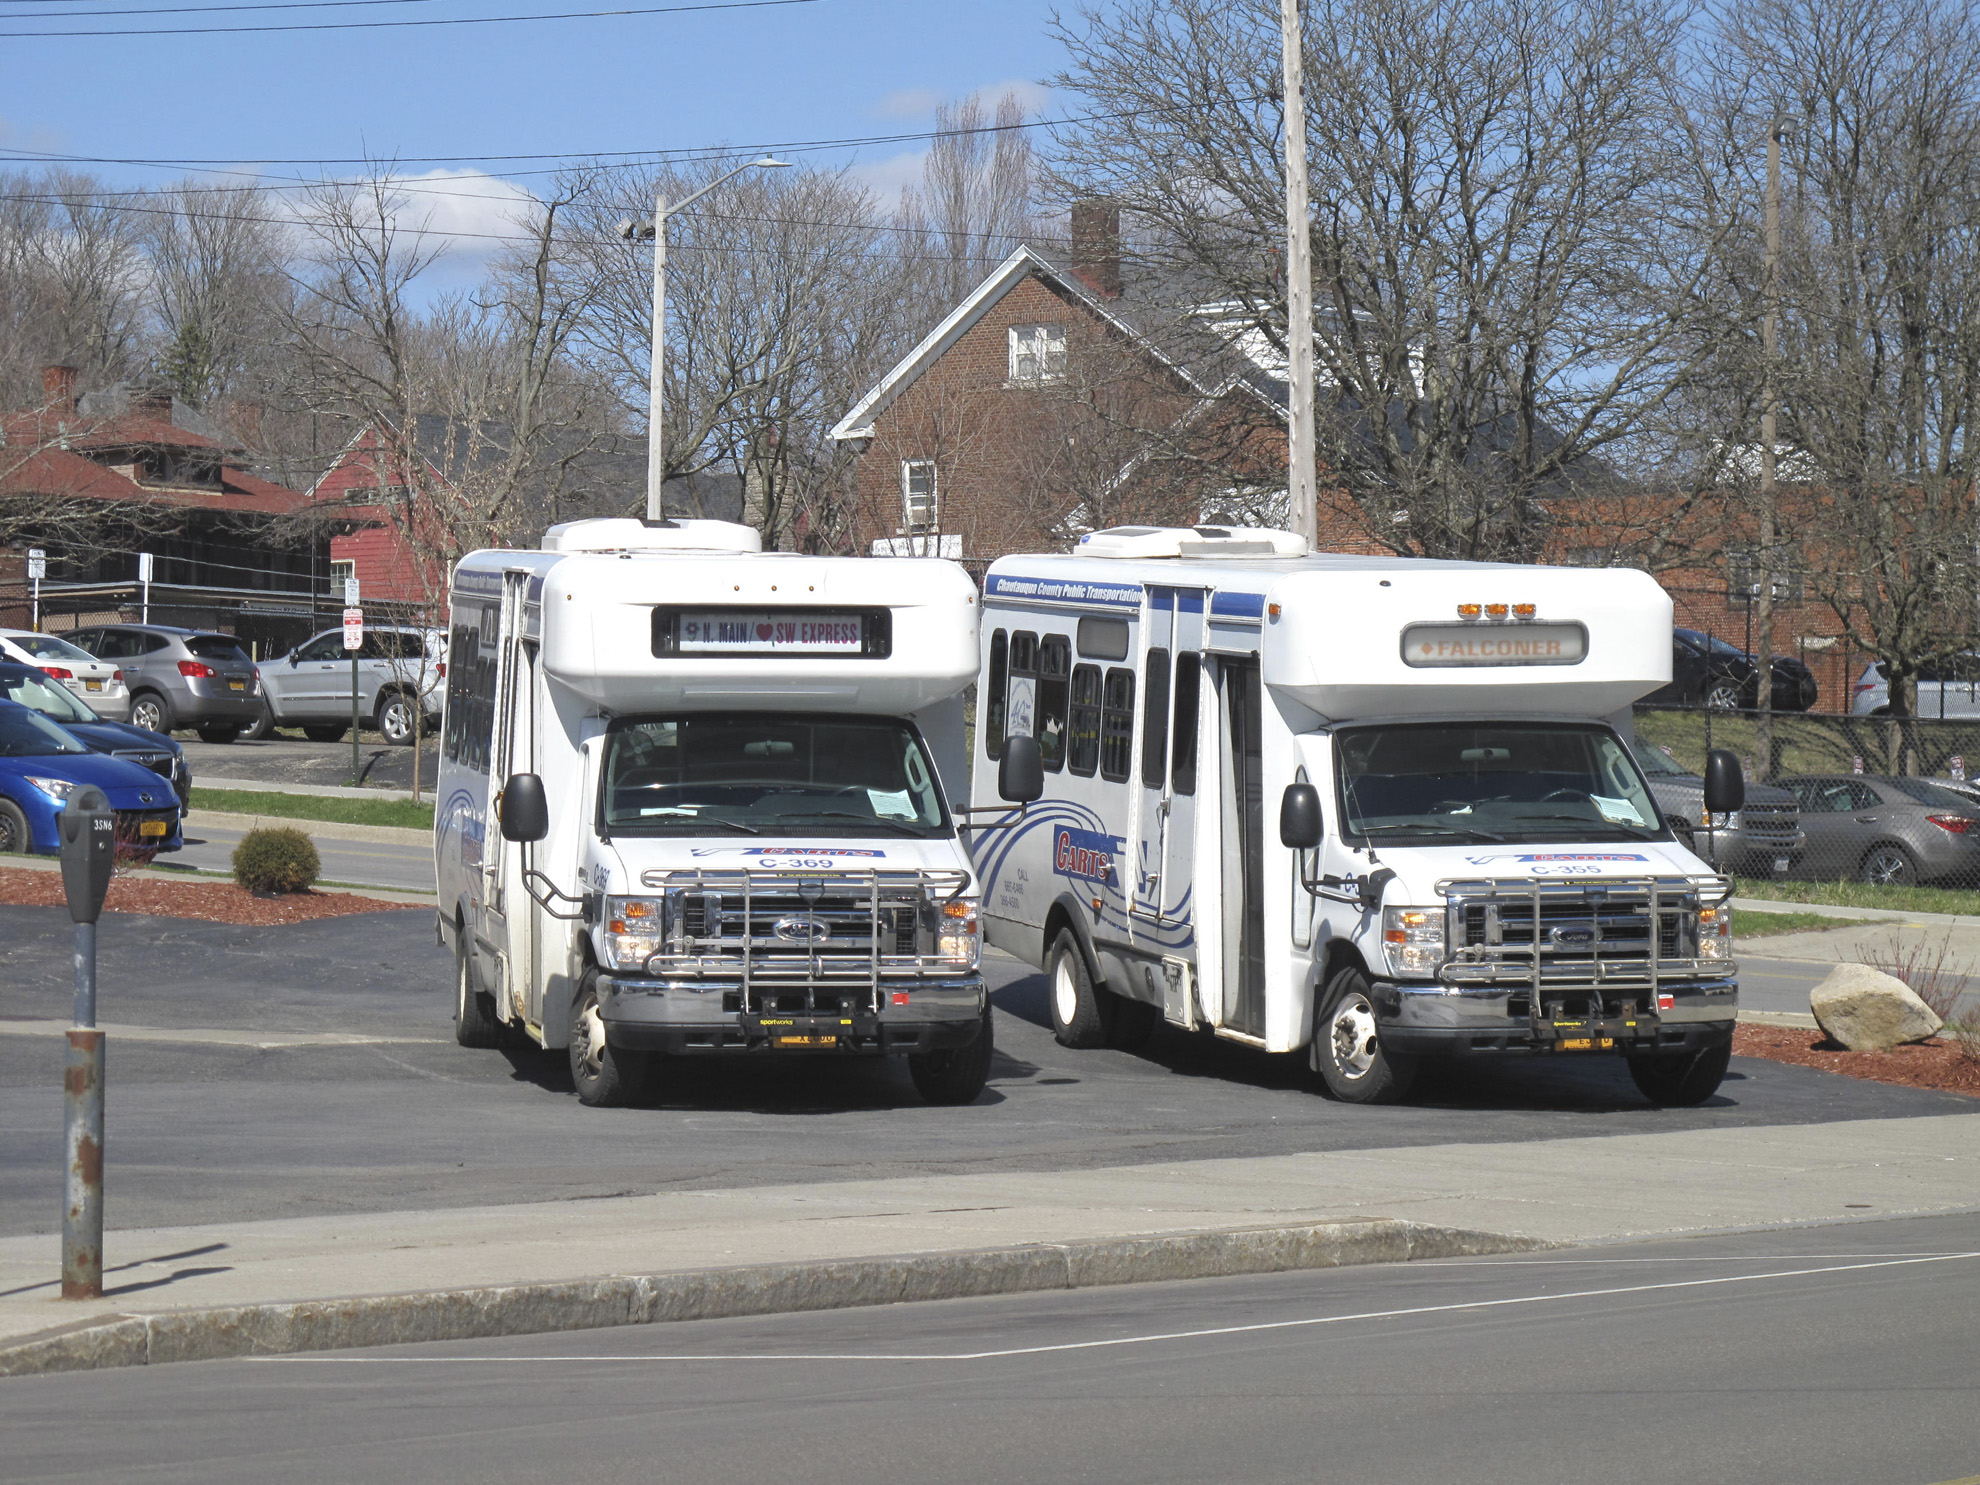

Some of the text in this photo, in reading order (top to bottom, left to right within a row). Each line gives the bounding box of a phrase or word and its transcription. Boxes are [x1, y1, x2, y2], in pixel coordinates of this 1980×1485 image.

[997, 579, 1144, 603] Chautauqua County Public Transportation
[776, 622, 797, 644] SW
[802, 623, 858, 644] EXPRESS
[1437, 640, 1562, 656] FALCONER
[94, 820, 113, 831] 3SN6
[1056, 830, 1109, 880] CARTS
[759, 858, 834, 869] C-369
[1531, 865, 1602, 875] C-355
